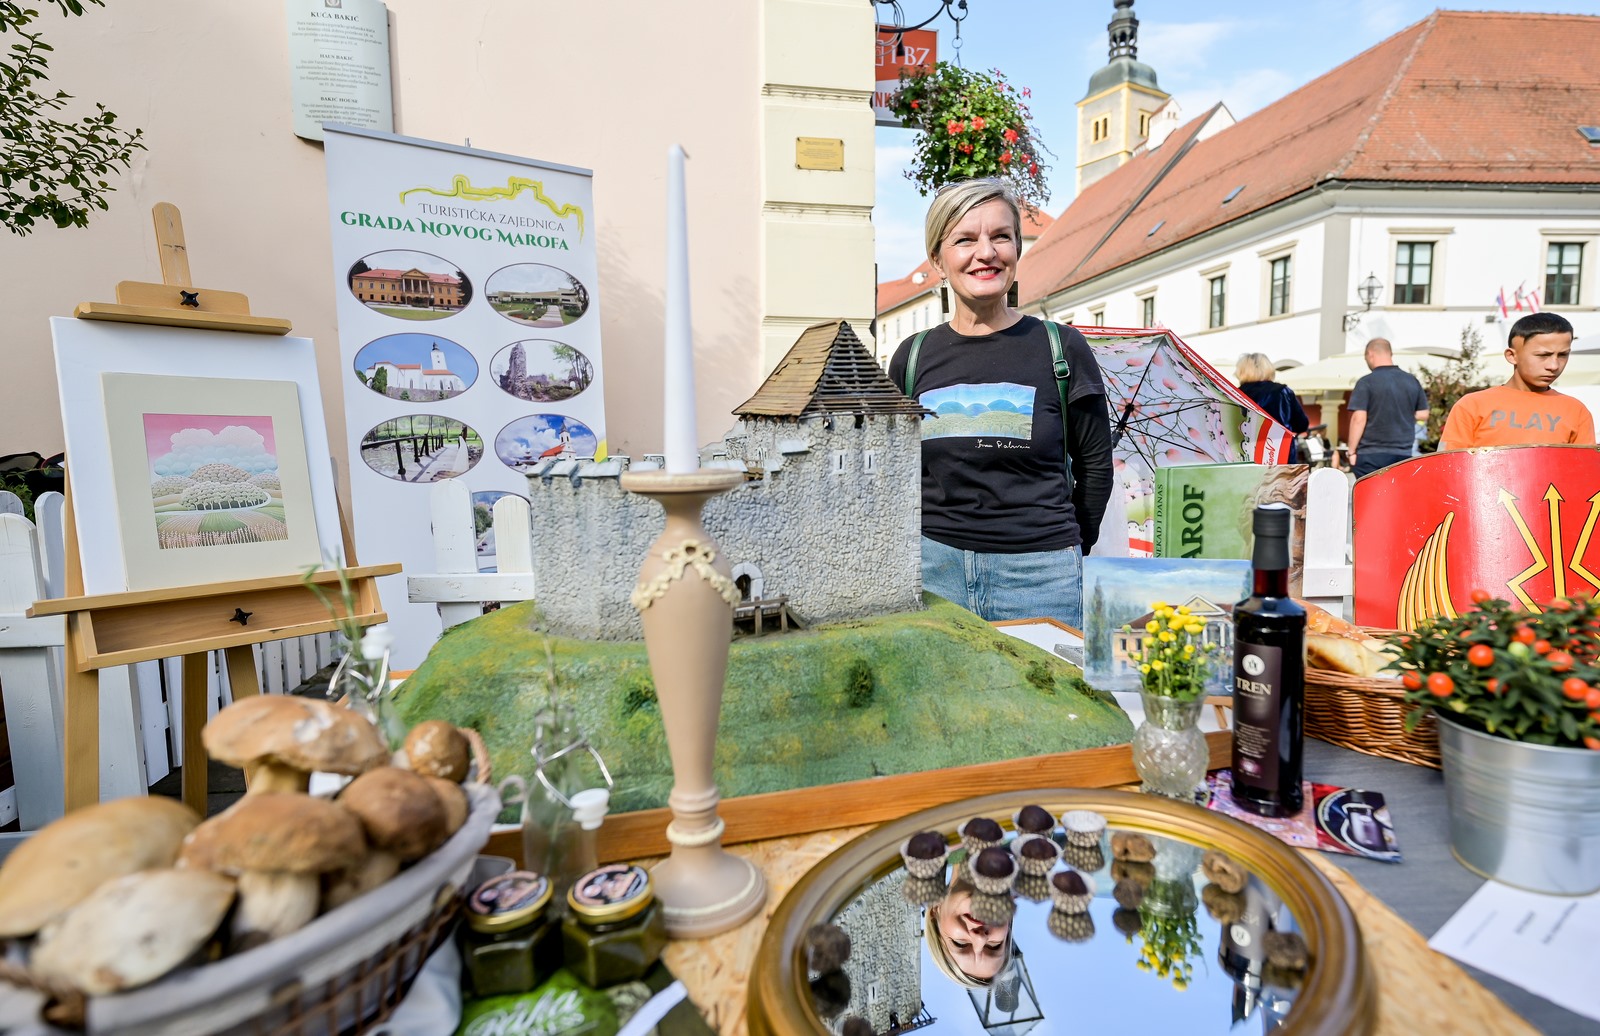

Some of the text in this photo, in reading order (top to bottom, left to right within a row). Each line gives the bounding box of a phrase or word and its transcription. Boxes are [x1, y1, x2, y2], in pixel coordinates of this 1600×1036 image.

[310, 10, 332, 19] KUĆA
[418, 202, 565, 232] TURISTIČKA ZAJEDNICA
[340, 211, 569, 251] GRADA NOVOG MAROFA
[1489, 409, 1562, 432] PLAY
[1235, 676, 1272, 696] TREN
